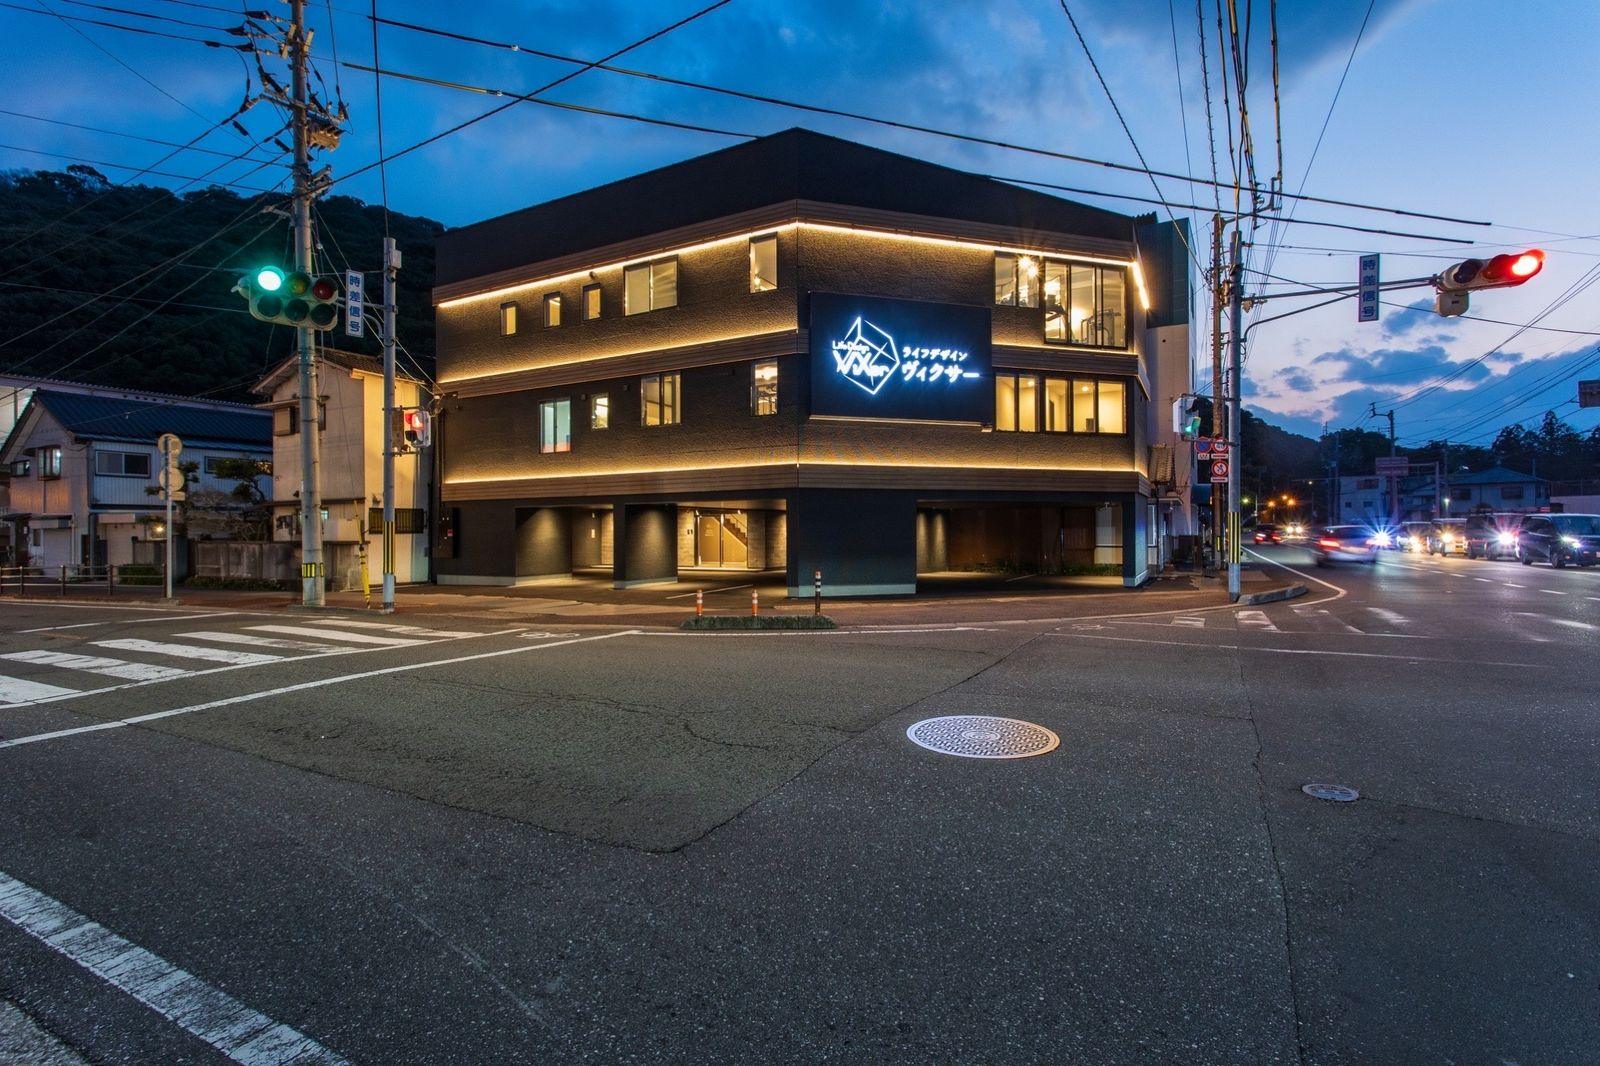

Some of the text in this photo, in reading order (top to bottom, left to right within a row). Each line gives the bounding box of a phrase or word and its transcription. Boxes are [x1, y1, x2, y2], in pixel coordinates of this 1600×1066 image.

[349, 275, 361, 332] 時差信号
[1362, 259, 1377, 318] 時差信号
[901, 360, 980, 383] ヴィクサー
[902, 346, 968, 361] ライフデザイン
